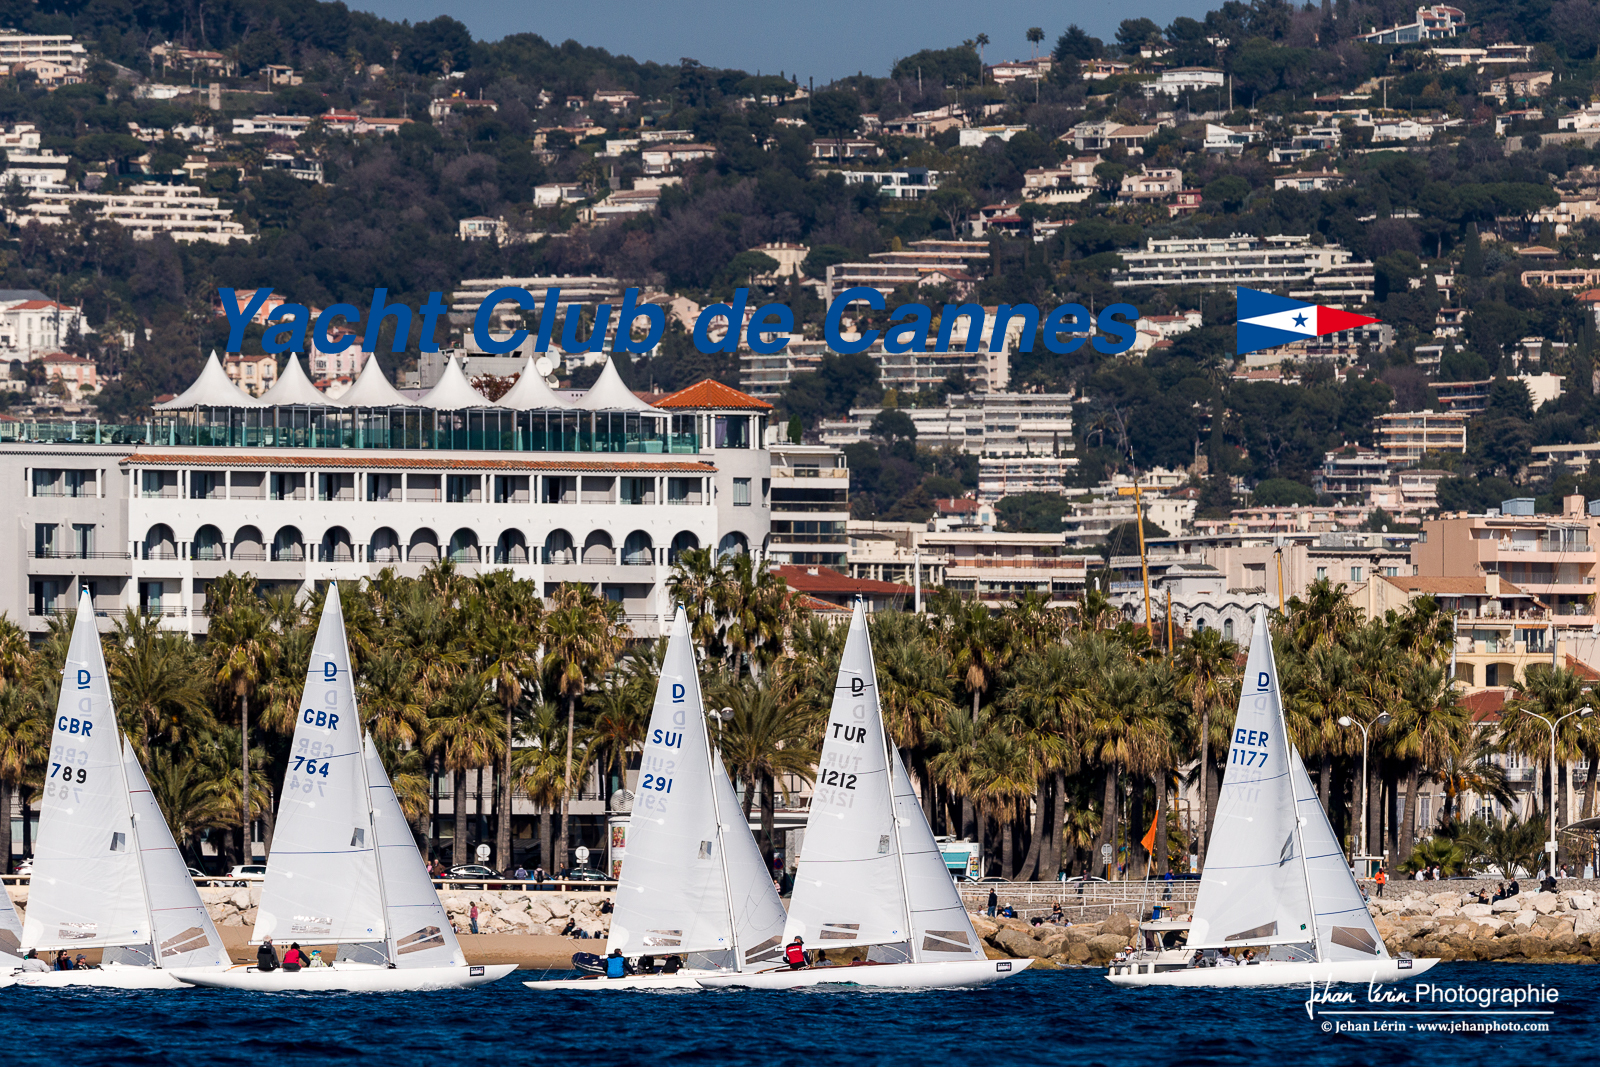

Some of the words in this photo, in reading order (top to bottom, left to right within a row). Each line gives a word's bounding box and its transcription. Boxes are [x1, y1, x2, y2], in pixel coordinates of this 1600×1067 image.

[77, 669, 91, 685] D
[324, 661, 338, 678] D
[1257, 671, 1270, 687] D
[672, 683, 686, 699] D
[851, 677, 864, 693] D
[58, 715, 93, 737] GBR
[303, 708, 339, 731] GBR
[652, 728, 683, 749] SUI
[832, 722, 867, 744] TUR
[1234, 728, 1269, 747] GER
[292, 755, 330, 778] 764
[1232, 748, 1269, 768] 1177
[50, 762, 87, 784] 789
[641, 773, 673, 794] 291
[820, 768, 858, 790] 1212
